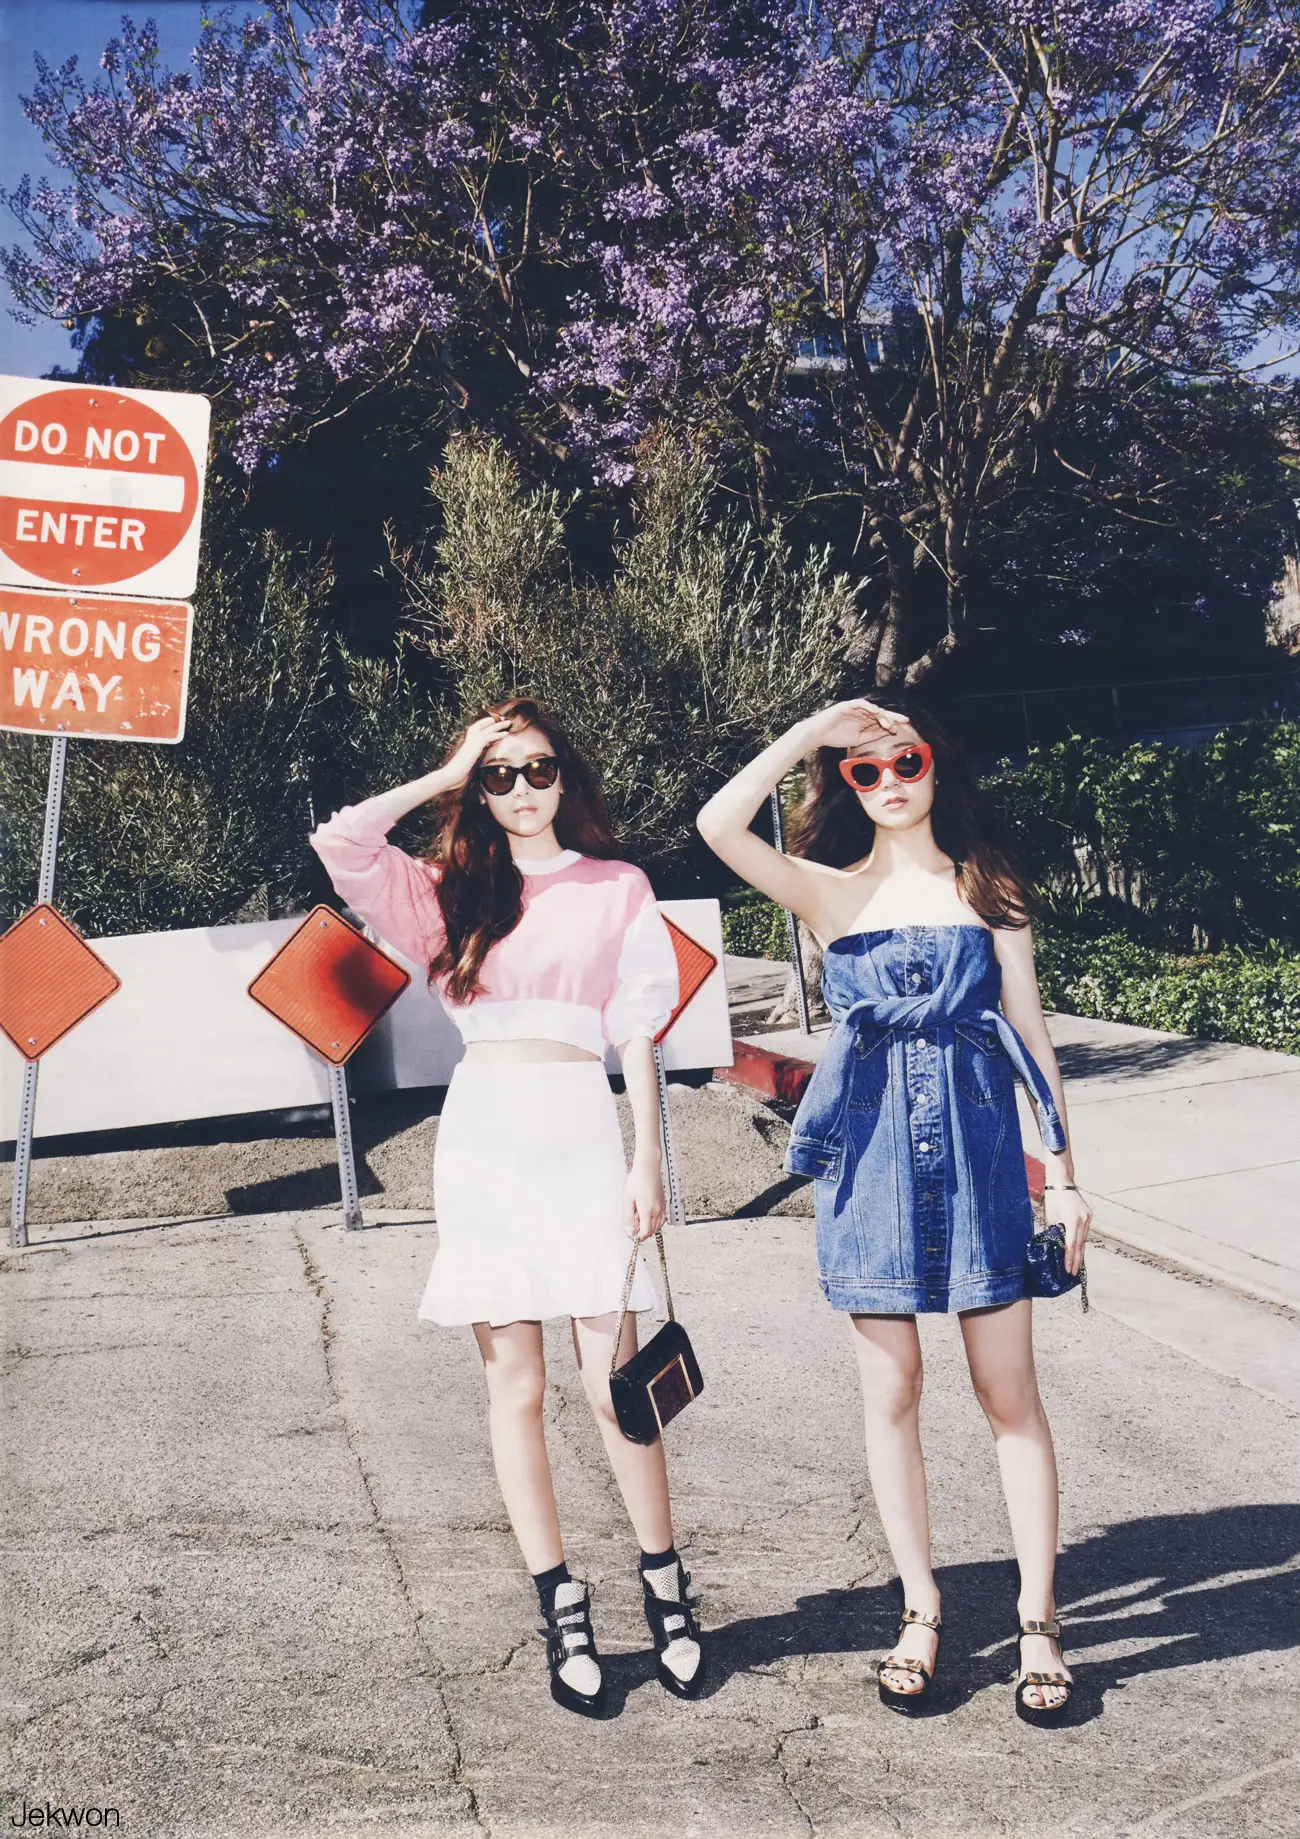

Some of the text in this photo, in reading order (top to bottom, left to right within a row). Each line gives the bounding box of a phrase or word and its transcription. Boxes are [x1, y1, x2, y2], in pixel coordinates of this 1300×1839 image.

[14, 420, 166, 464] DO NOT
[16, 509, 146, 551] ENTER
[13, 667, 123, 712] WAY
